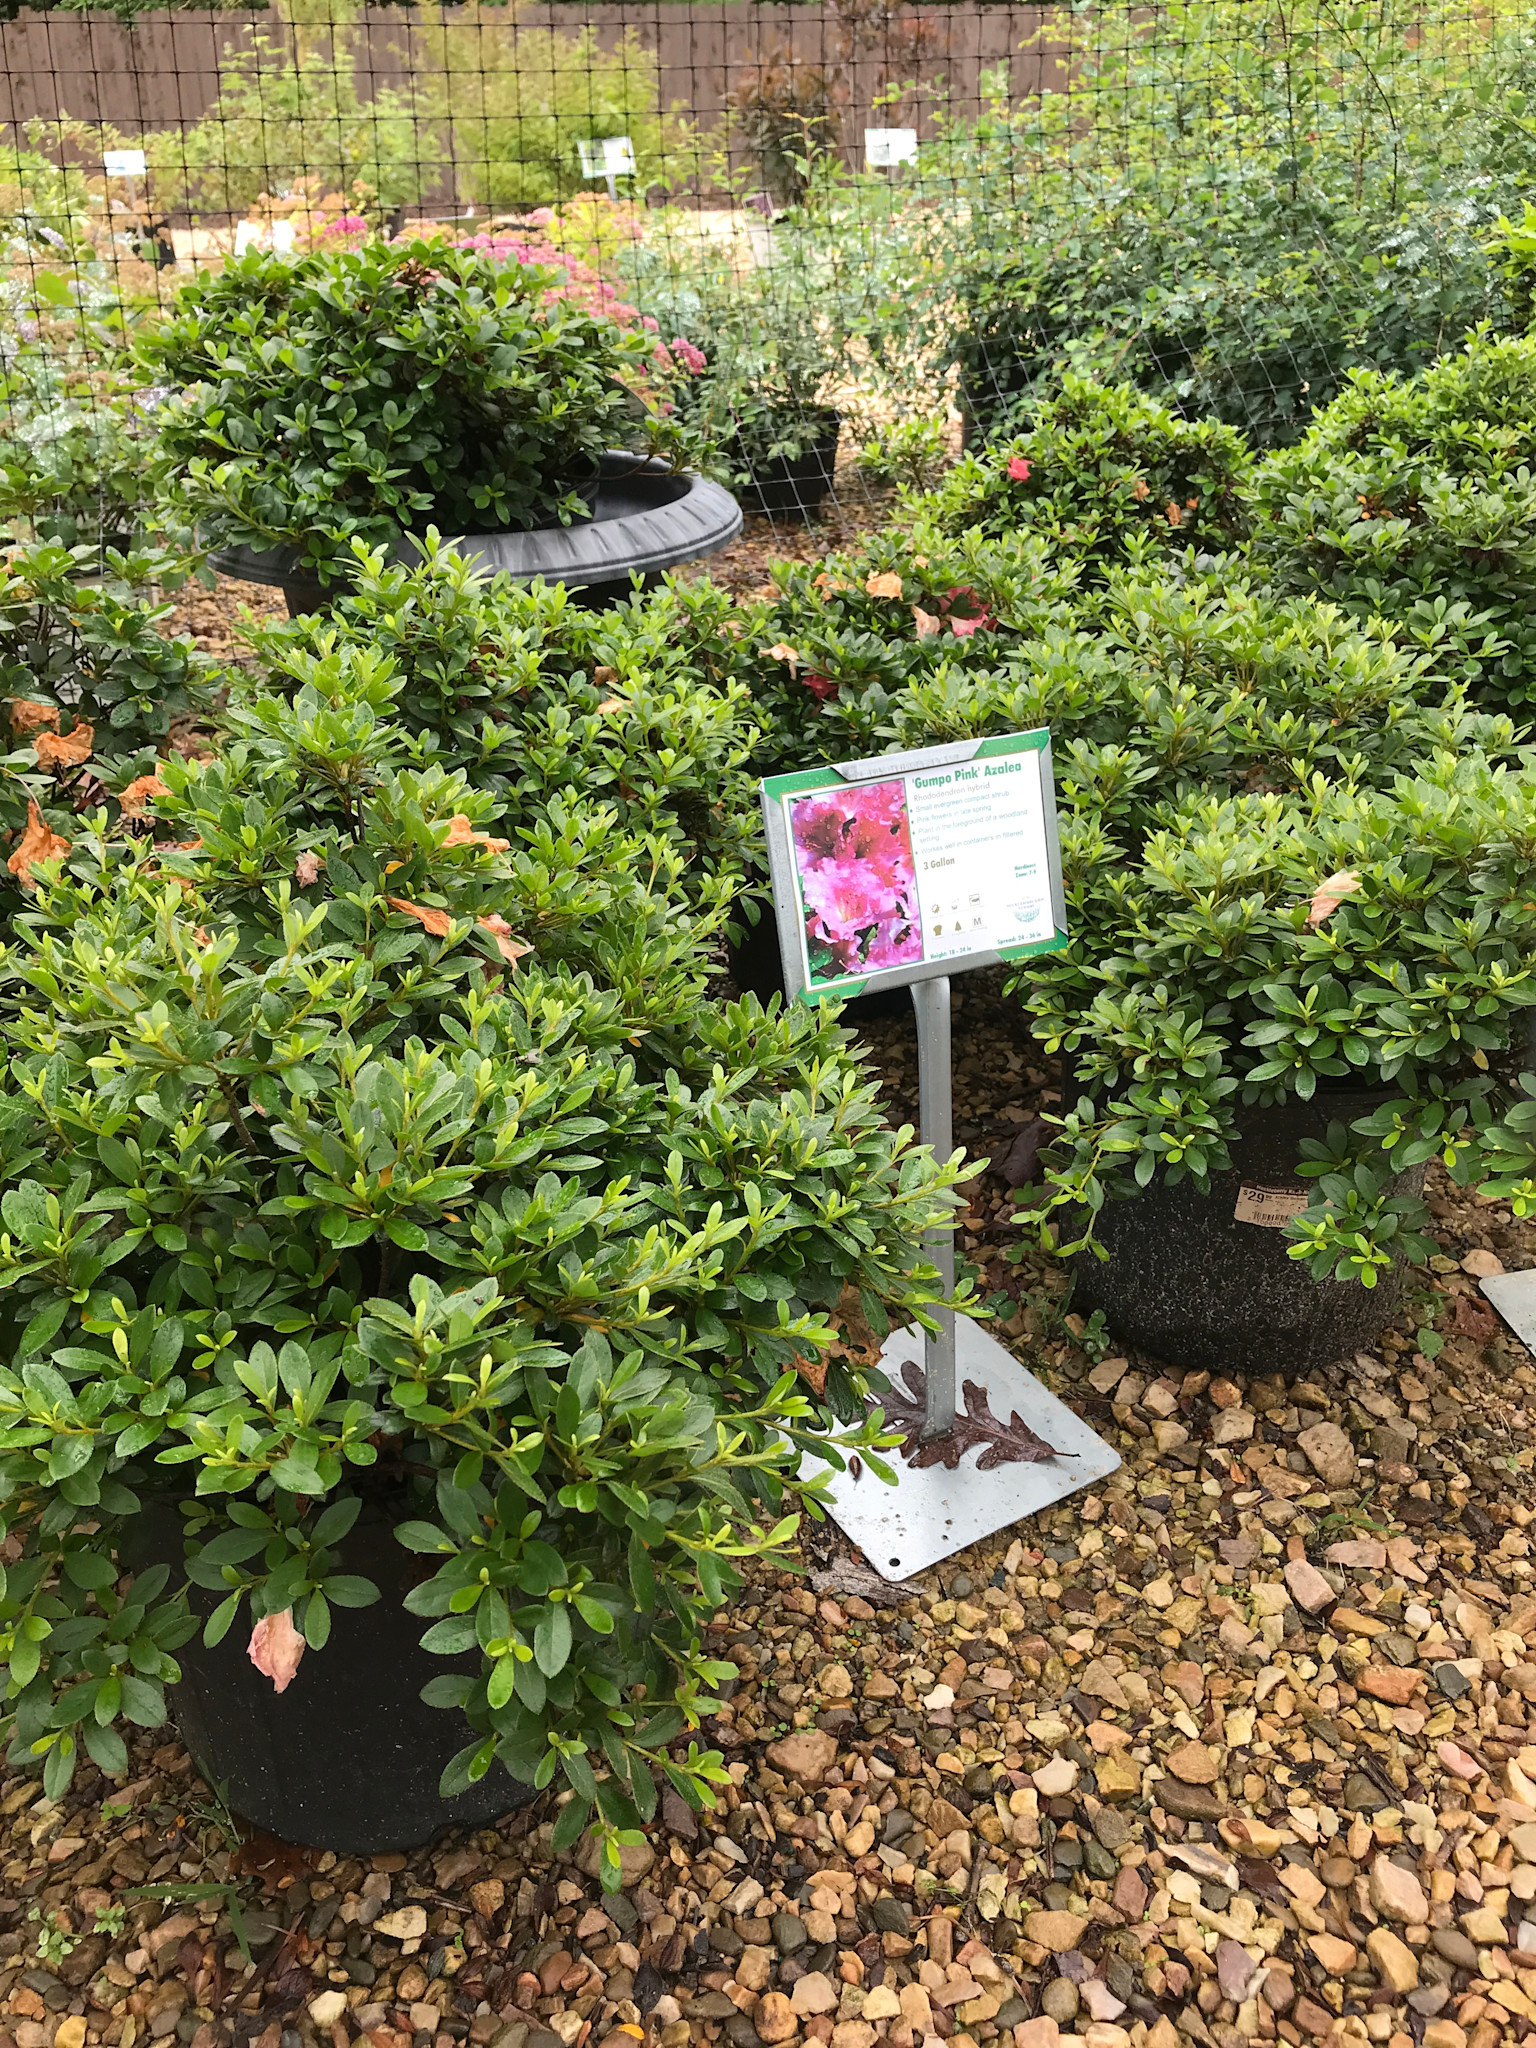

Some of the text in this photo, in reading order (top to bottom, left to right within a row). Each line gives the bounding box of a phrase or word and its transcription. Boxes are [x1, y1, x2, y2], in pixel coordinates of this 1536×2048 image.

[911, 774, 952, 789] 'Gumpo
[954, 766, 980, 781] Pink'
[984, 761, 1022, 777] Azalea
[913, 781, 990, 801] Rhododendron hybrid
[915, 790, 1010, 812] Small evergreen compact shrub
[931, 811, 952, 820] flowers
[972, 804, 992, 814] spring
[942, 822, 952, 830] the
[952, 816, 983, 828] foreground
[998, 808, 1028, 819] woodland
[944, 842, 955, 850] well
[963, 835, 994, 846] containers
[923, 857, 956, 870] 3 Gallon
[997, 936, 1017, 946] Spread:
[930, 951, 948, 960] Height:
